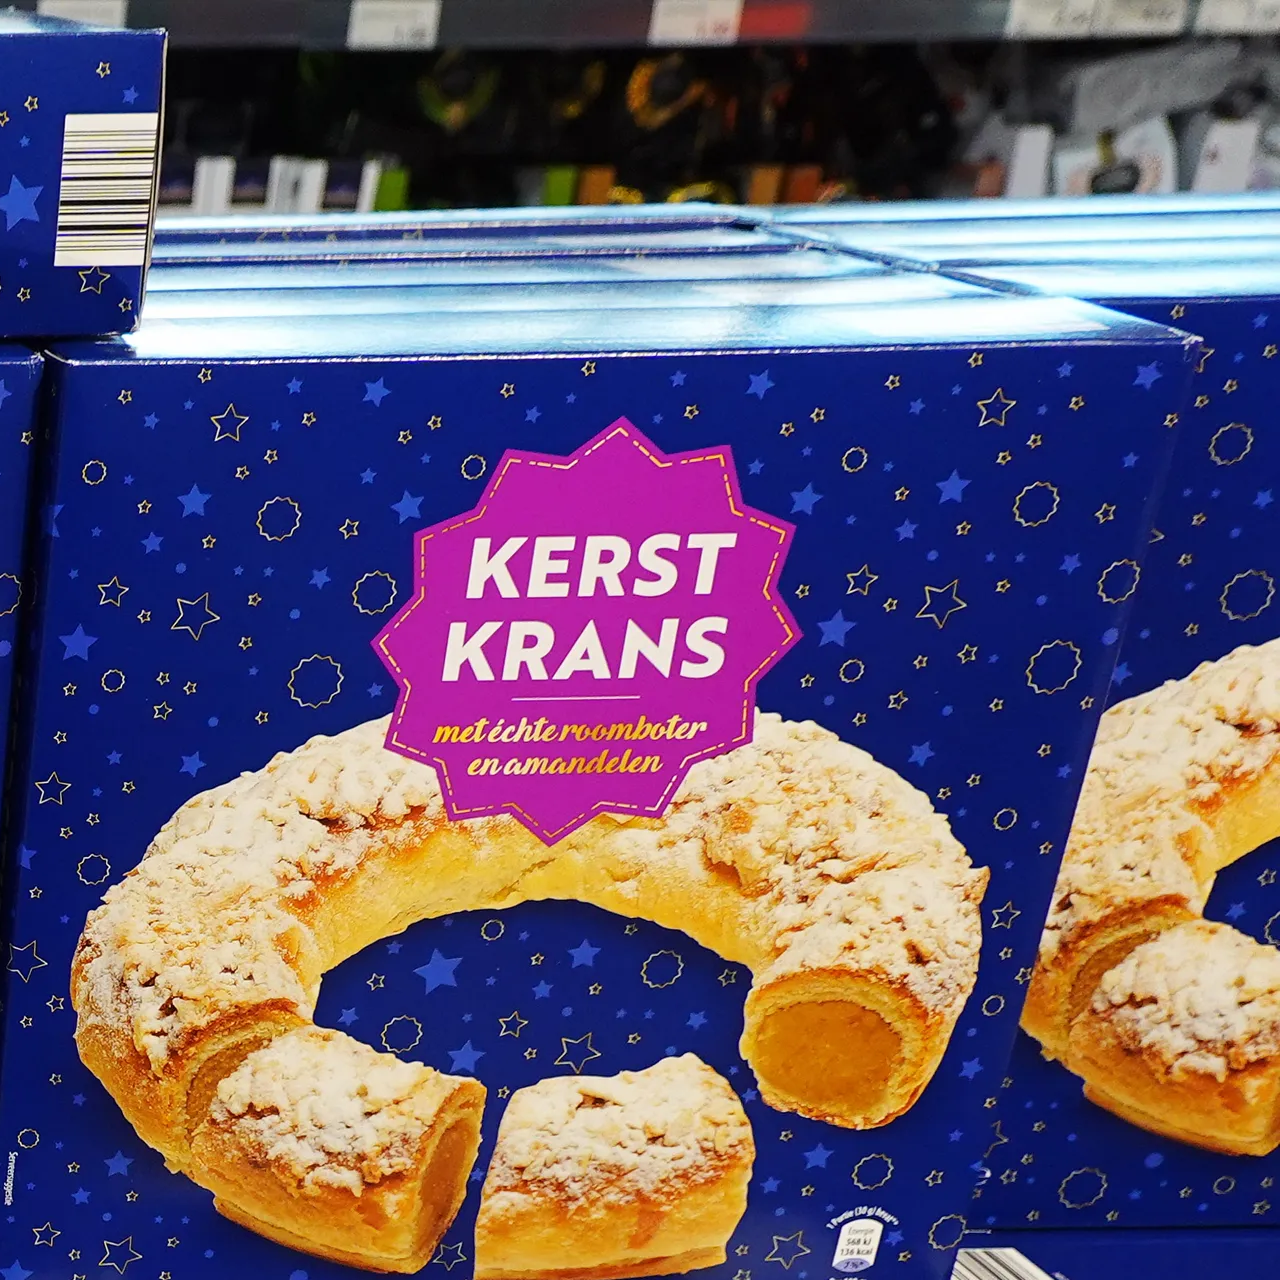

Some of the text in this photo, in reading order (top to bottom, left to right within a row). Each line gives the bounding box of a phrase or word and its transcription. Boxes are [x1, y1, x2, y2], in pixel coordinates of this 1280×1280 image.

[466, 533, 738, 599] KERST
[441, 617, 729, 682] KRANS
[433, 718, 488, 744] met
[558, 715, 708, 742] roomboter
[467, 750, 663, 776] en amandelen
